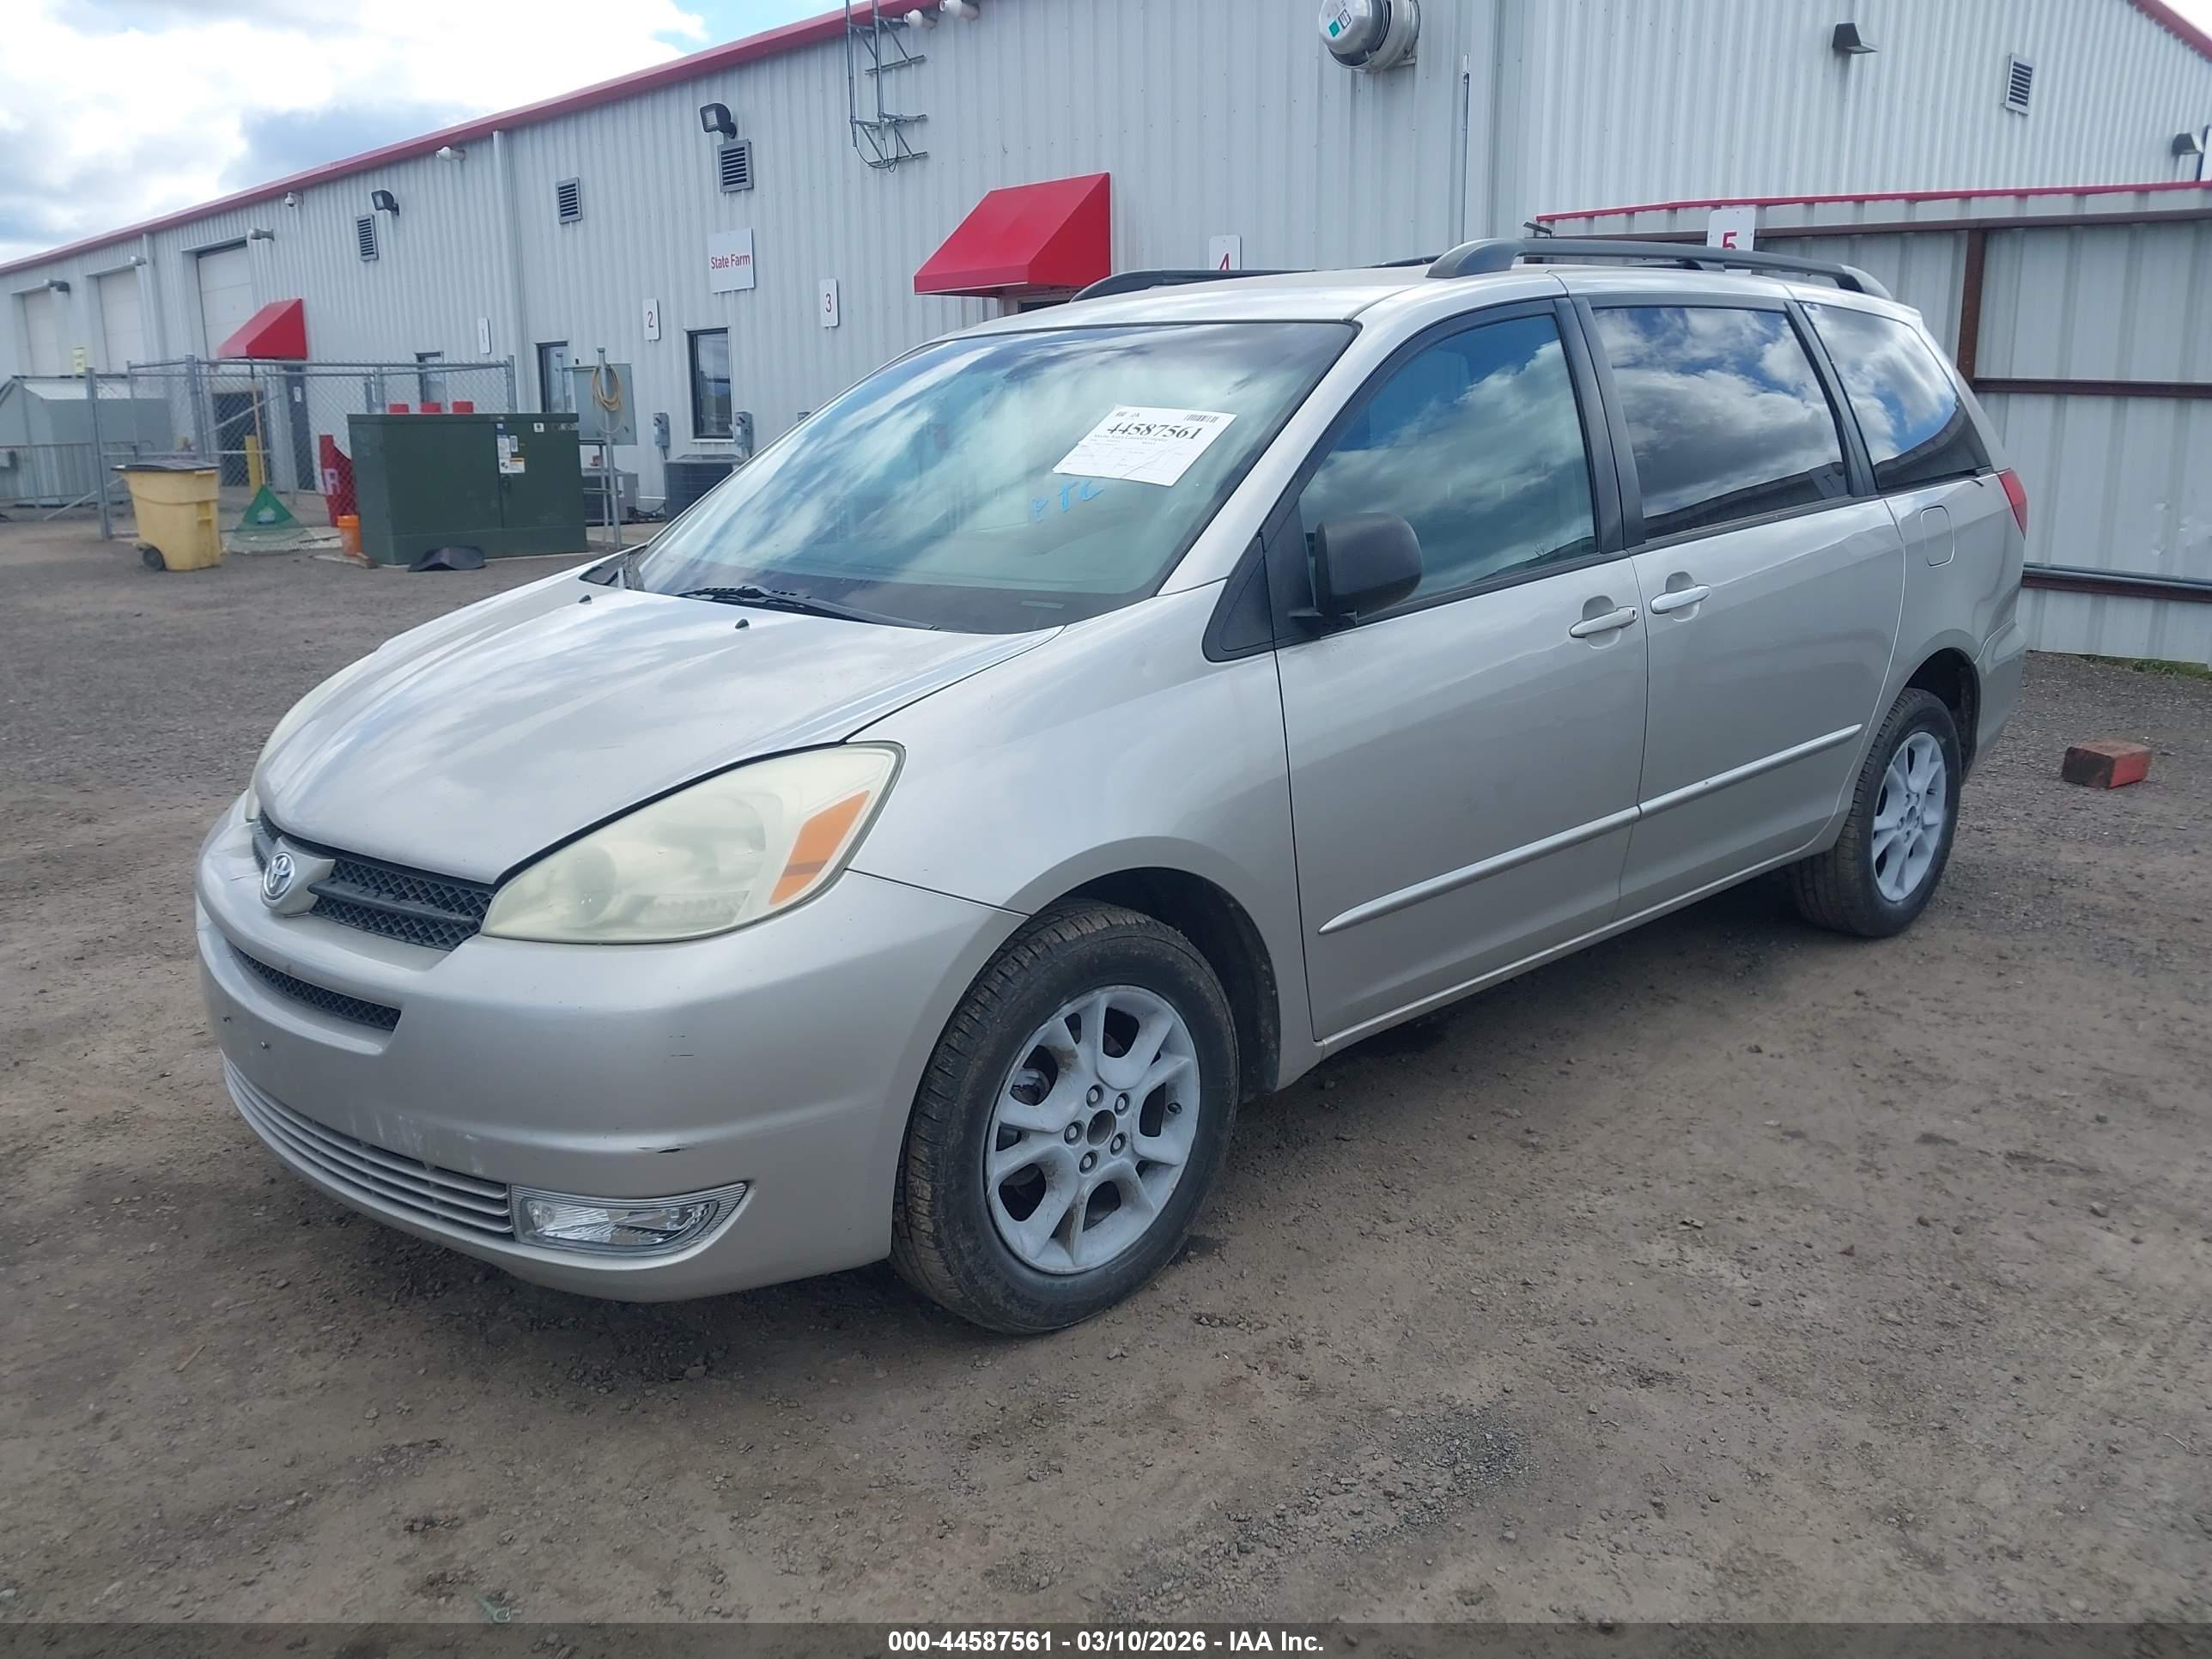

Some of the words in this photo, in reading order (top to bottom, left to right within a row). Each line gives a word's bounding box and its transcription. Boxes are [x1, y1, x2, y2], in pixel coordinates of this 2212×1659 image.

[710, 255, 730, 270] State
[730, 253, 750, 267] Farm
[825, 293, 832, 313] 3
[647, 310, 654, 328] 2
[1107, 422, 1203, 440] 44587561
